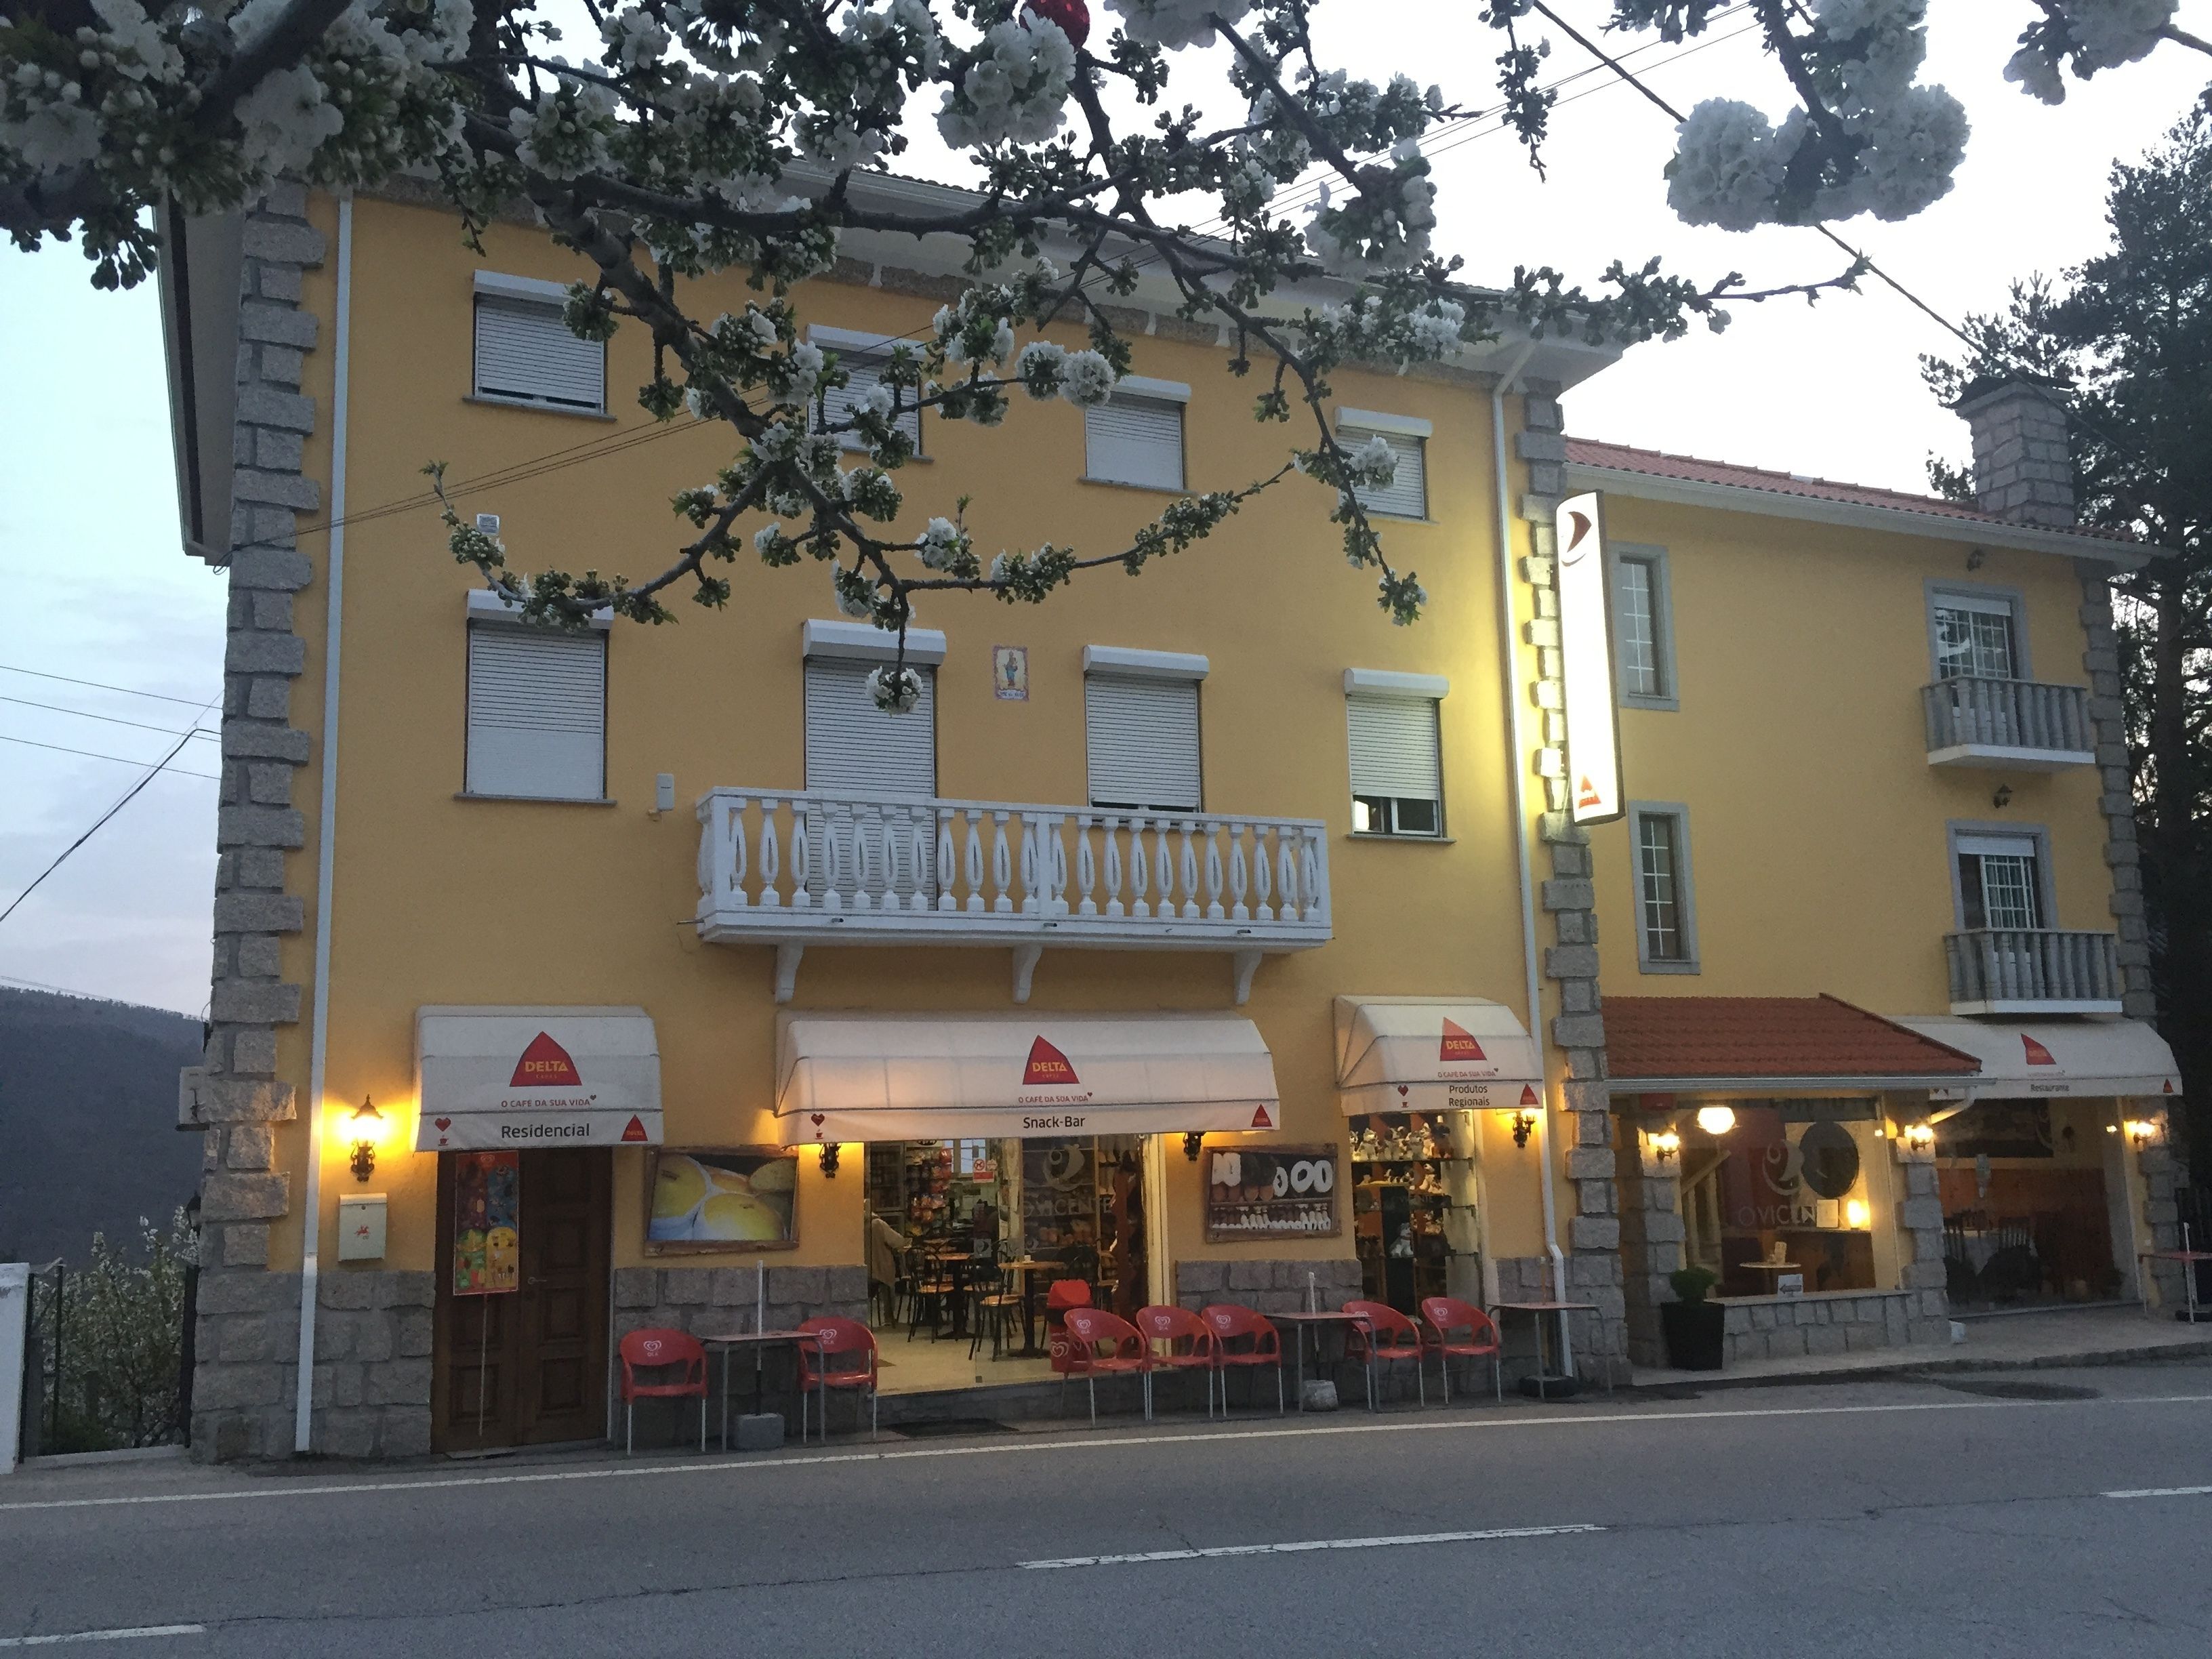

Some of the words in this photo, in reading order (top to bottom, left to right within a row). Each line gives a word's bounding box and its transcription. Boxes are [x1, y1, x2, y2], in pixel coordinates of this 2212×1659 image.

[1446, 1040, 1475, 1050] DELTA
[525, 1061, 569, 1073] DELTA
[1032, 1062, 1068, 1072] DELTA
[1449, 1085, 1488, 1094] Produtos
[550, 1099, 567, 1107] SUA
[1025, 1095, 1044, 1103] CAFÉ
[1448, 1097, 1490, 1107] Regionais
[1023, 1115, 1086, 1128] Snack-Bar
[501, 1123, 590, 1139] Residencial
